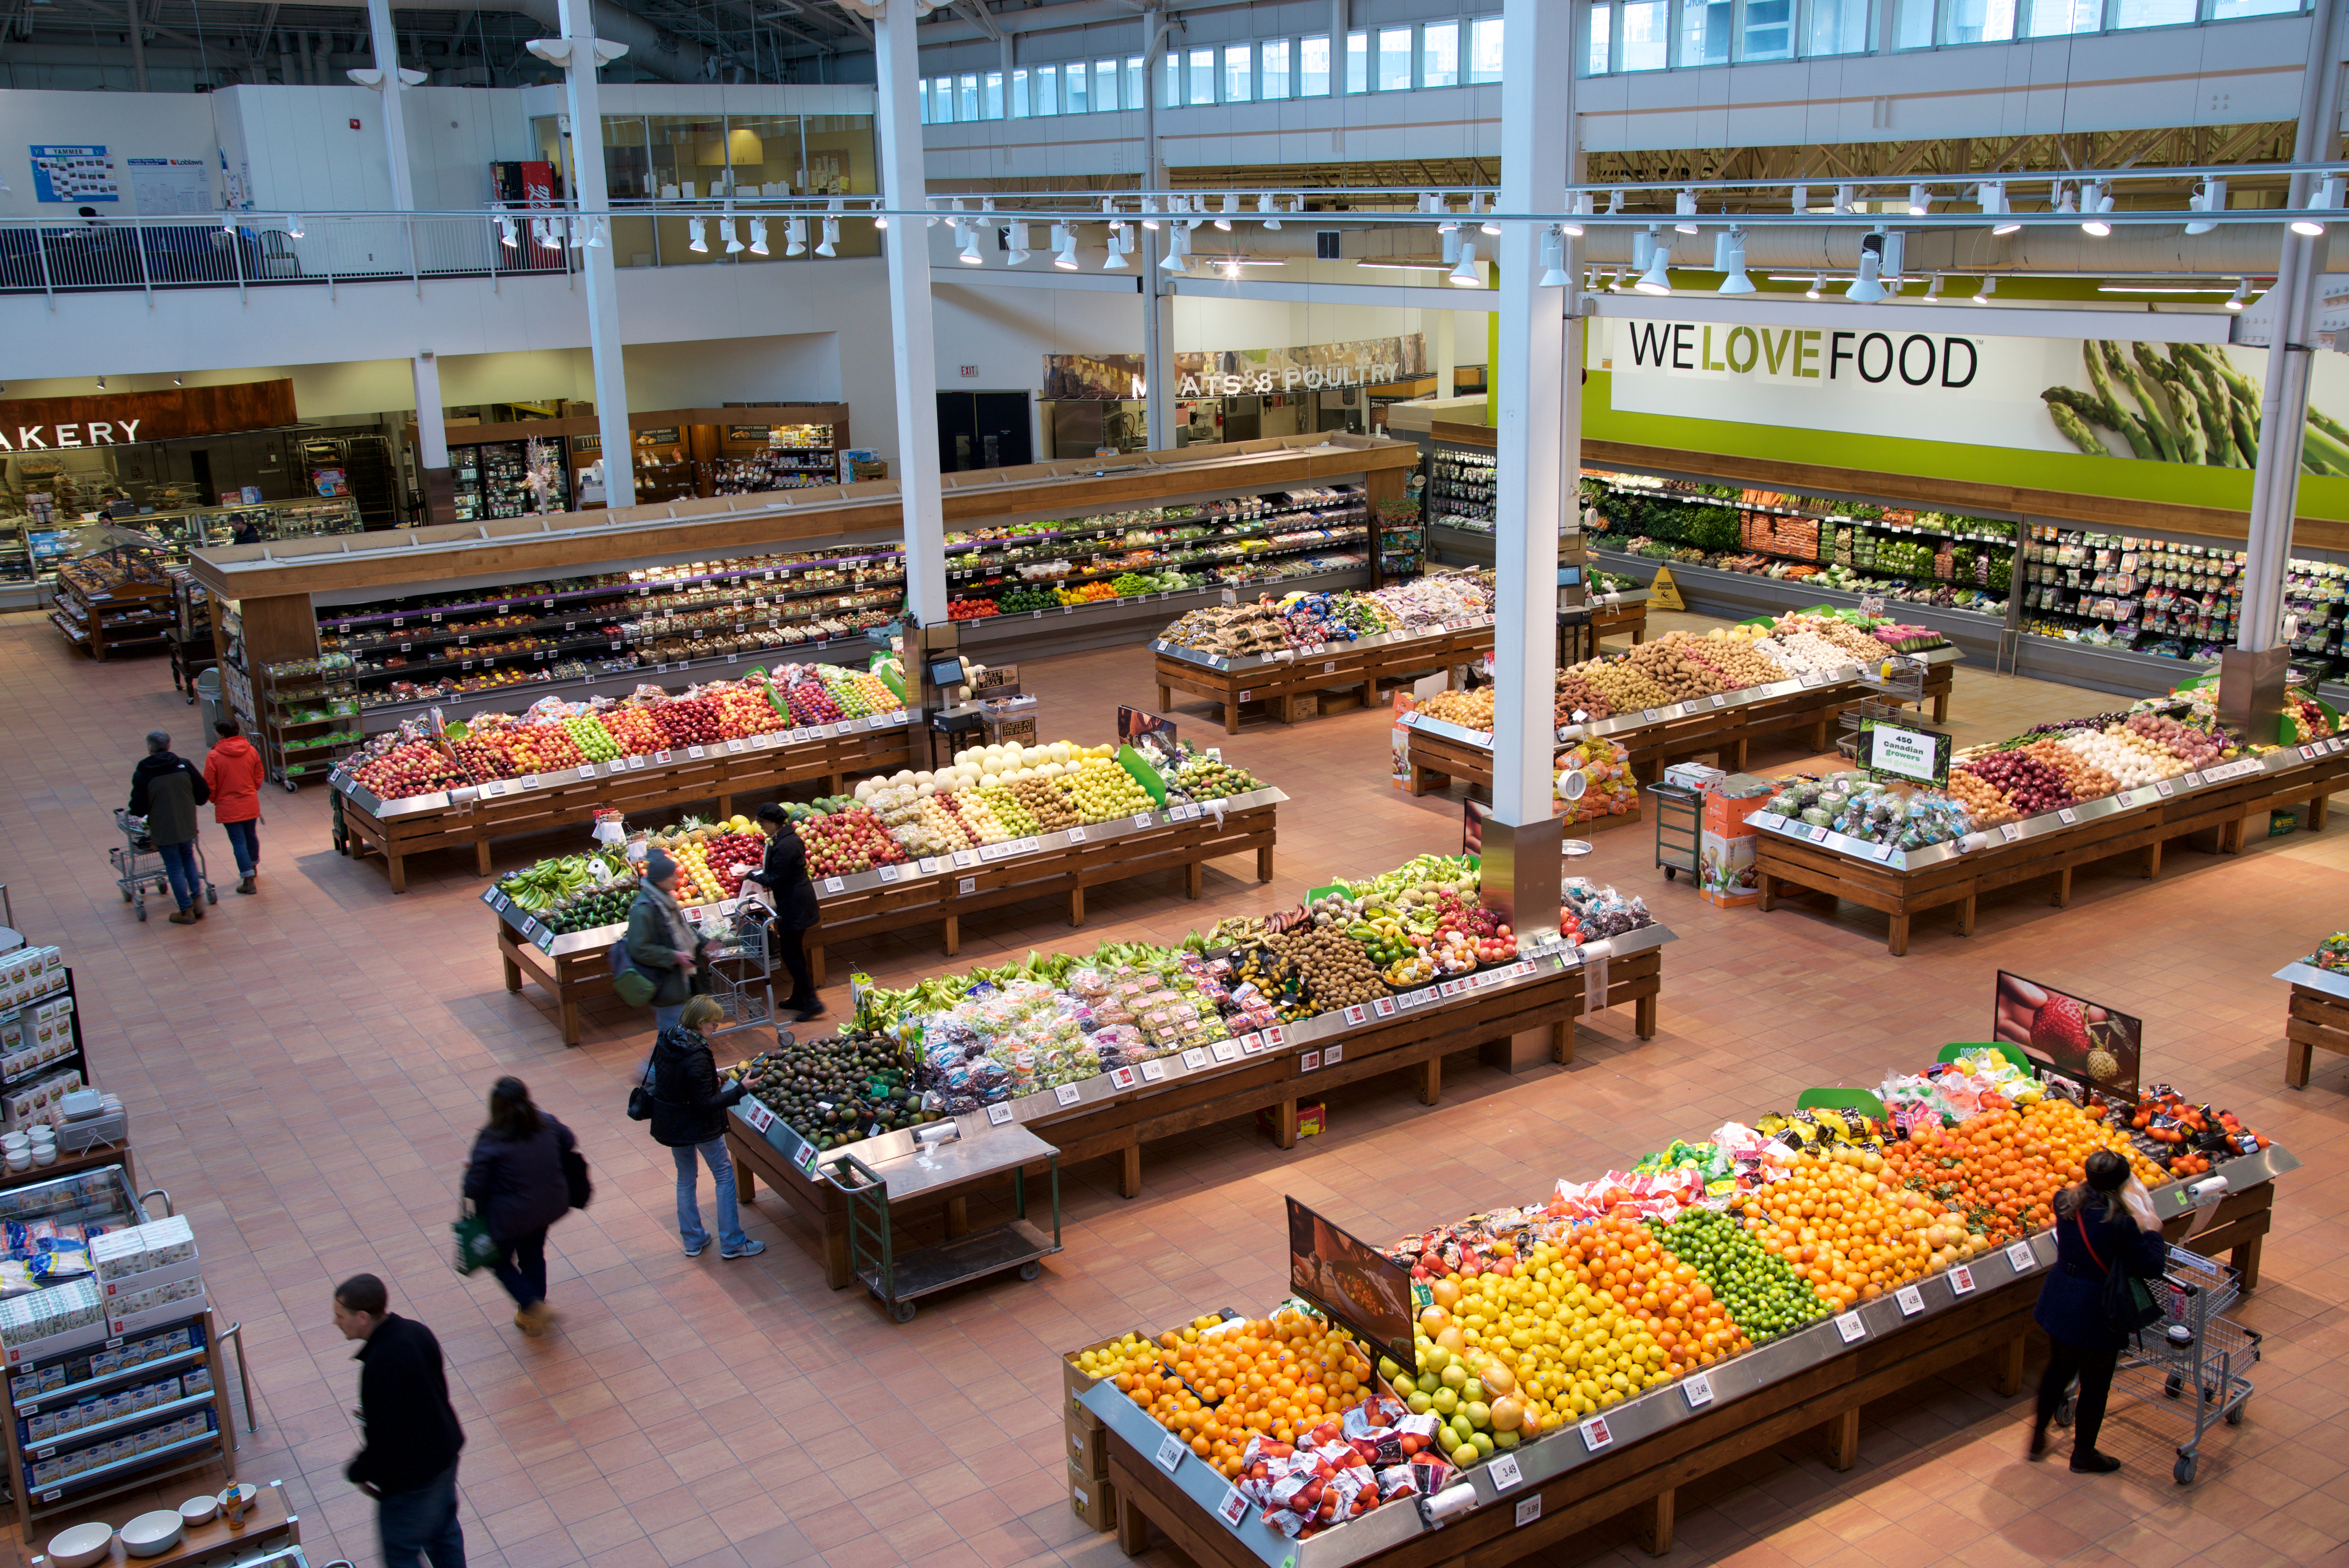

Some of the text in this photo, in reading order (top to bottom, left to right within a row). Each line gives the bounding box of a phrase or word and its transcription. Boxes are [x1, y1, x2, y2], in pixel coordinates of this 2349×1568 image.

[961, 366, 975, 375] EXIT
[1285, 362, 1399, 393] POULTRY
[771, 690, 782, 707] ORGANIC
[1003, 721, 1023, 730] TASTE
[1884, 741, 1923, 755] Canadian
[1886, 749, 1920, 762] growers
[1894, 759, 1928, 774] growing
[2019, 1252, 2029, 1261] 3.99
[1909, 1295, 1918, 1304] 4.99
[1849, 1321, 1859, 1331] 1.99
[1696, 1384, 1707, 1395] 2.49
[1593, 1423, 1606, 1434] 4/4.00
[1167, 1449, 1177, 1462] 1.99
[1503, 1464, 1517, 1477] 3.49
[1231, 1501, 1242, 1516] 5.99
[1527, 1503, 1539, 1515] 3.99
